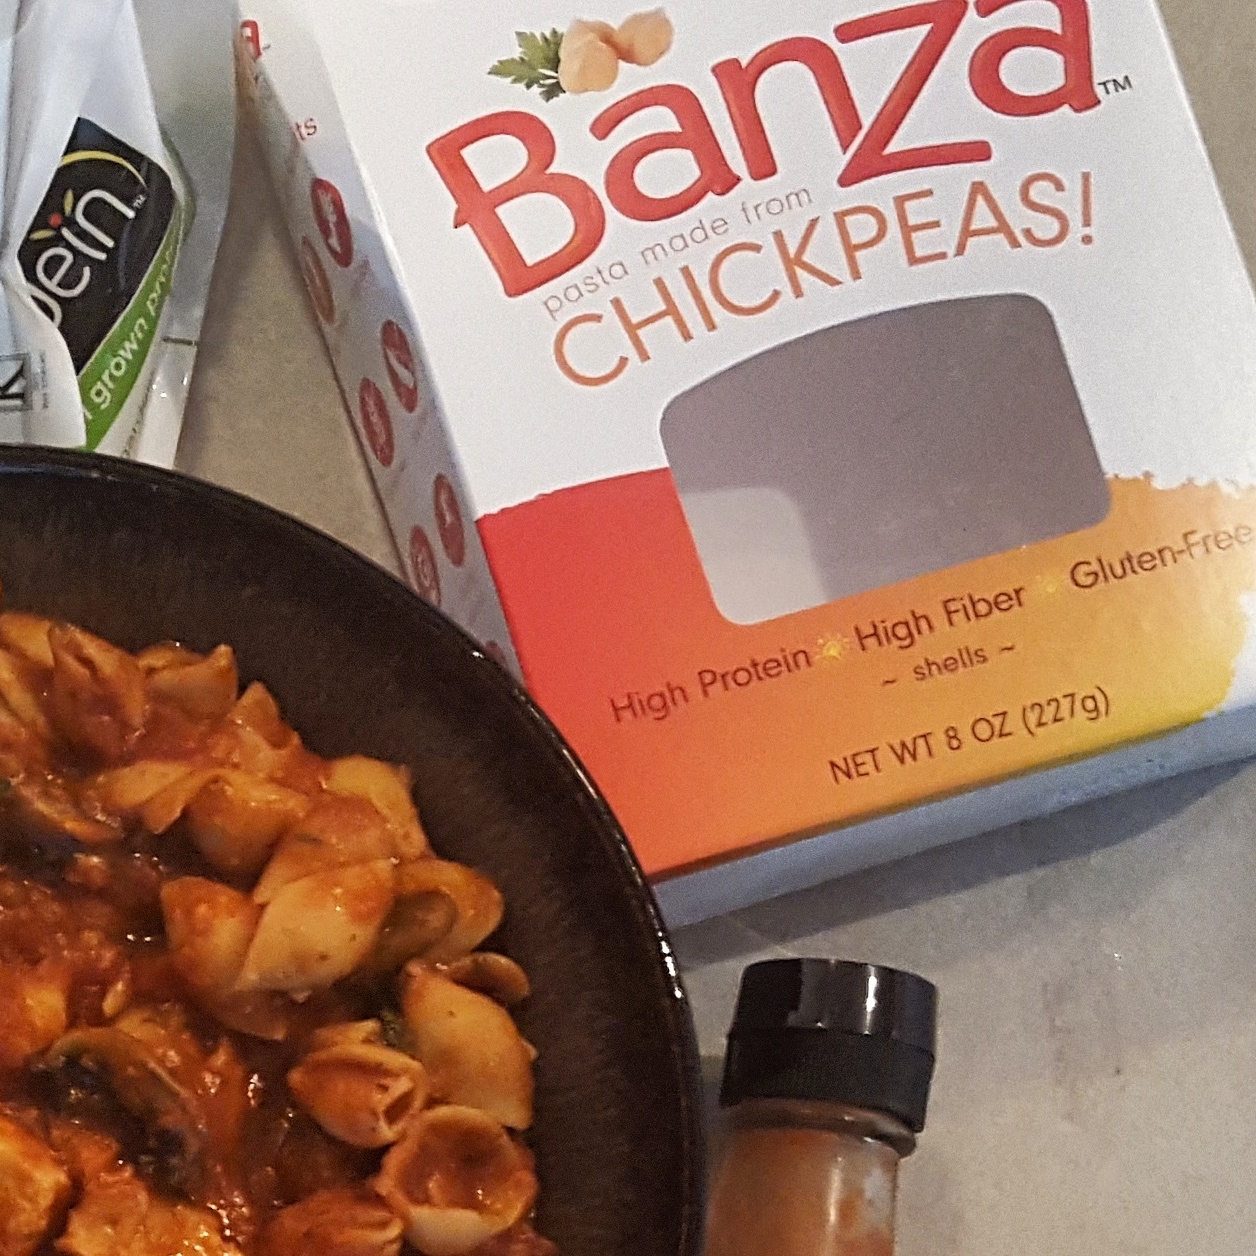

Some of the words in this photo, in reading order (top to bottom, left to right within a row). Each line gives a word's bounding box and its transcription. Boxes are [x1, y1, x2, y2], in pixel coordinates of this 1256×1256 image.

[426, 0, 1103, 298] Banza
[542, 261, 630, 321] pasta
[640, 213, 731, 267] made
[740, 184, 815, 227] from
[552, 170, 1096, 388] CHICKPEAS!
[88, 316, 151, 411] grown
[1069, 524, 1254, 590] Gluten-Free
[851, 609, 934, 656] High
[943, 583, 1027, 629] Fiber
[912, 643, 989, 683] shells
[609, 680, 690, 725] High
[697, 643, 814, 700] Protein
[829, 746, 883, 786] NET
[887, 731, 936, 766] WT
[945, 726, 963, 751] 8
[970, 710, 1014, 745] OZ
[1020, 685, 1112, 738] (227g)
